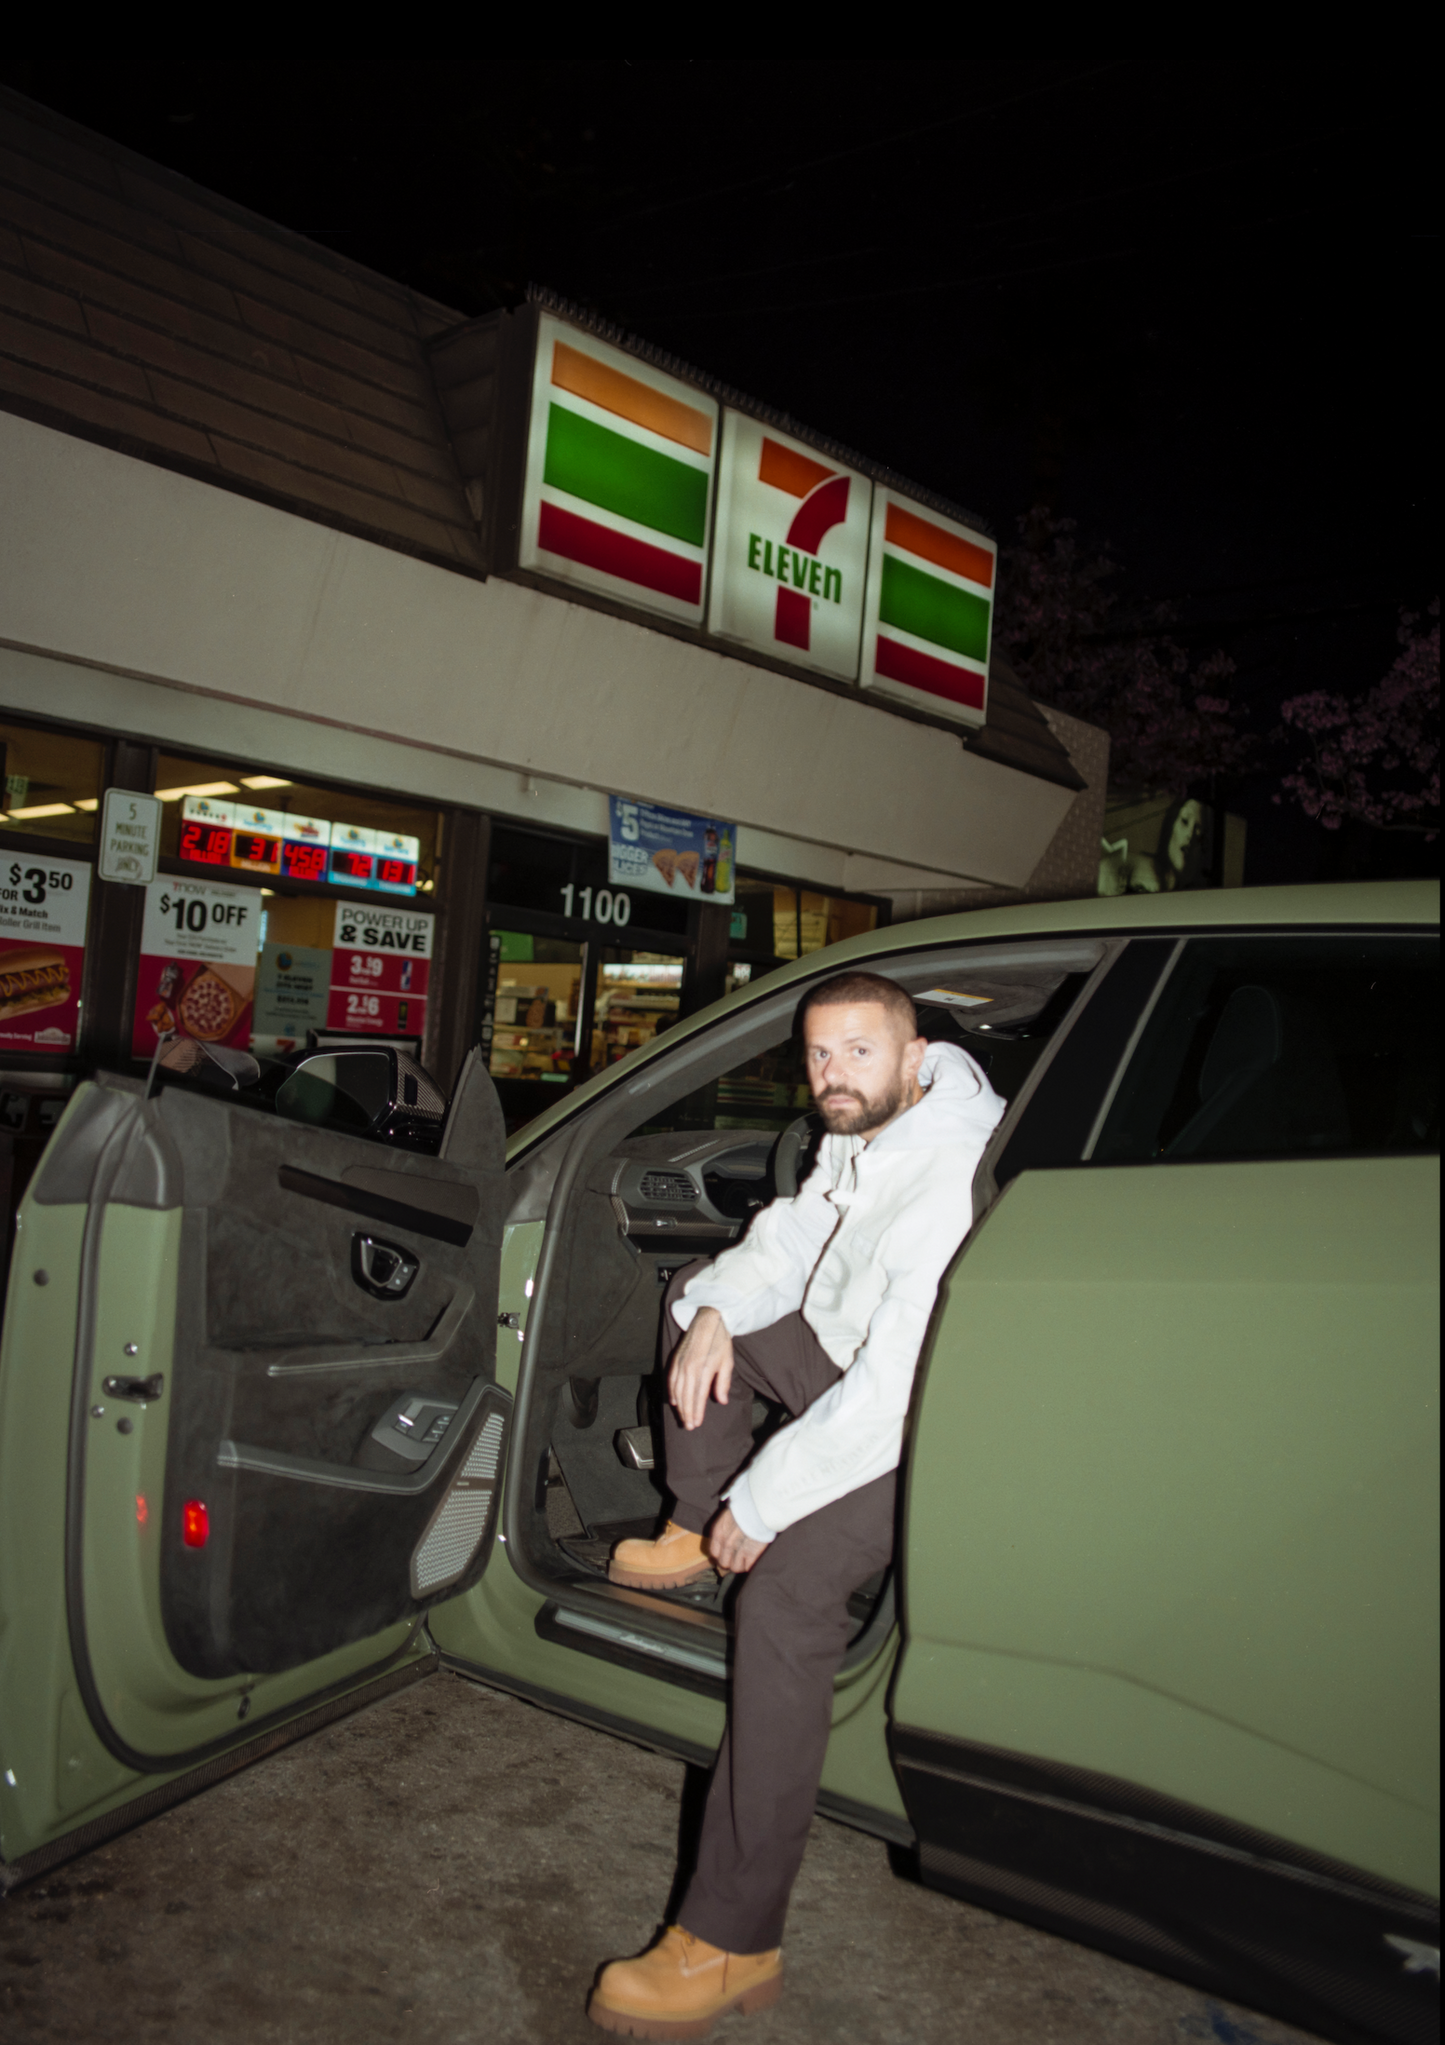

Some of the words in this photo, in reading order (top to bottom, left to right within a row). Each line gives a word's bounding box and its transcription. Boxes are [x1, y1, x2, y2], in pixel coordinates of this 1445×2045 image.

[128, 802, 138, 821] 5
[116, 822, 148, 840] MINUTE
[110, 838, 149, 857] PARKING
[284, 844, 327, 871] 458
[11, 905, 18, 915] &
[19, 906, 48, 919] Match
[160, 892, 208, 932] $10
[212, 903, 248, 926] OFF
[560, 882, 631, 928] 1100
[23, 919, 41, 931] Grill
[42, 920, 62, 933] Item
[342, 908, 402, 929] POWER
[406, 917, 429, 932] UP
[339, 924, 357, 942] &
[363, 927, 427, 952] SAVE
